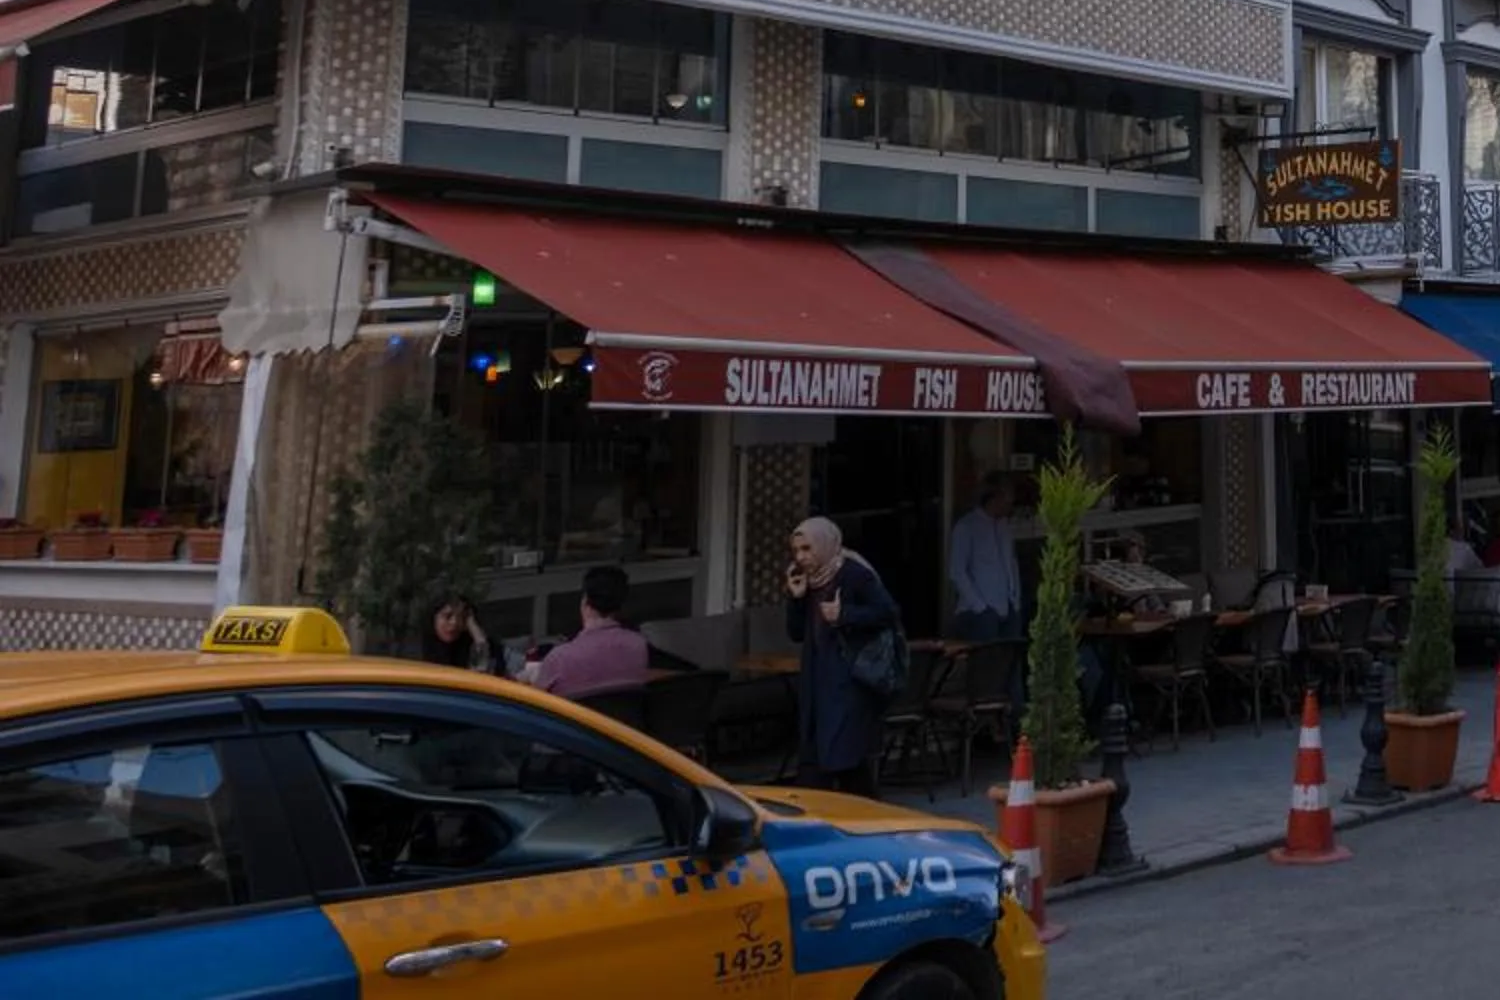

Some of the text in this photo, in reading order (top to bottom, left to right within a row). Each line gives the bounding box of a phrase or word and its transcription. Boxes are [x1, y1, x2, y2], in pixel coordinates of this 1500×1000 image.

[1266, 151, 1388, 196] SULTANAHMET
[1263, 200, 1390, 222] FISH HOUSE
[725, 358, 1045, 411] SULTANAHMET FISH HOUSE
[1197, 373, 1415, 407] CAFE & RESTAURANT
[714, 940, 783, 977] 1453
